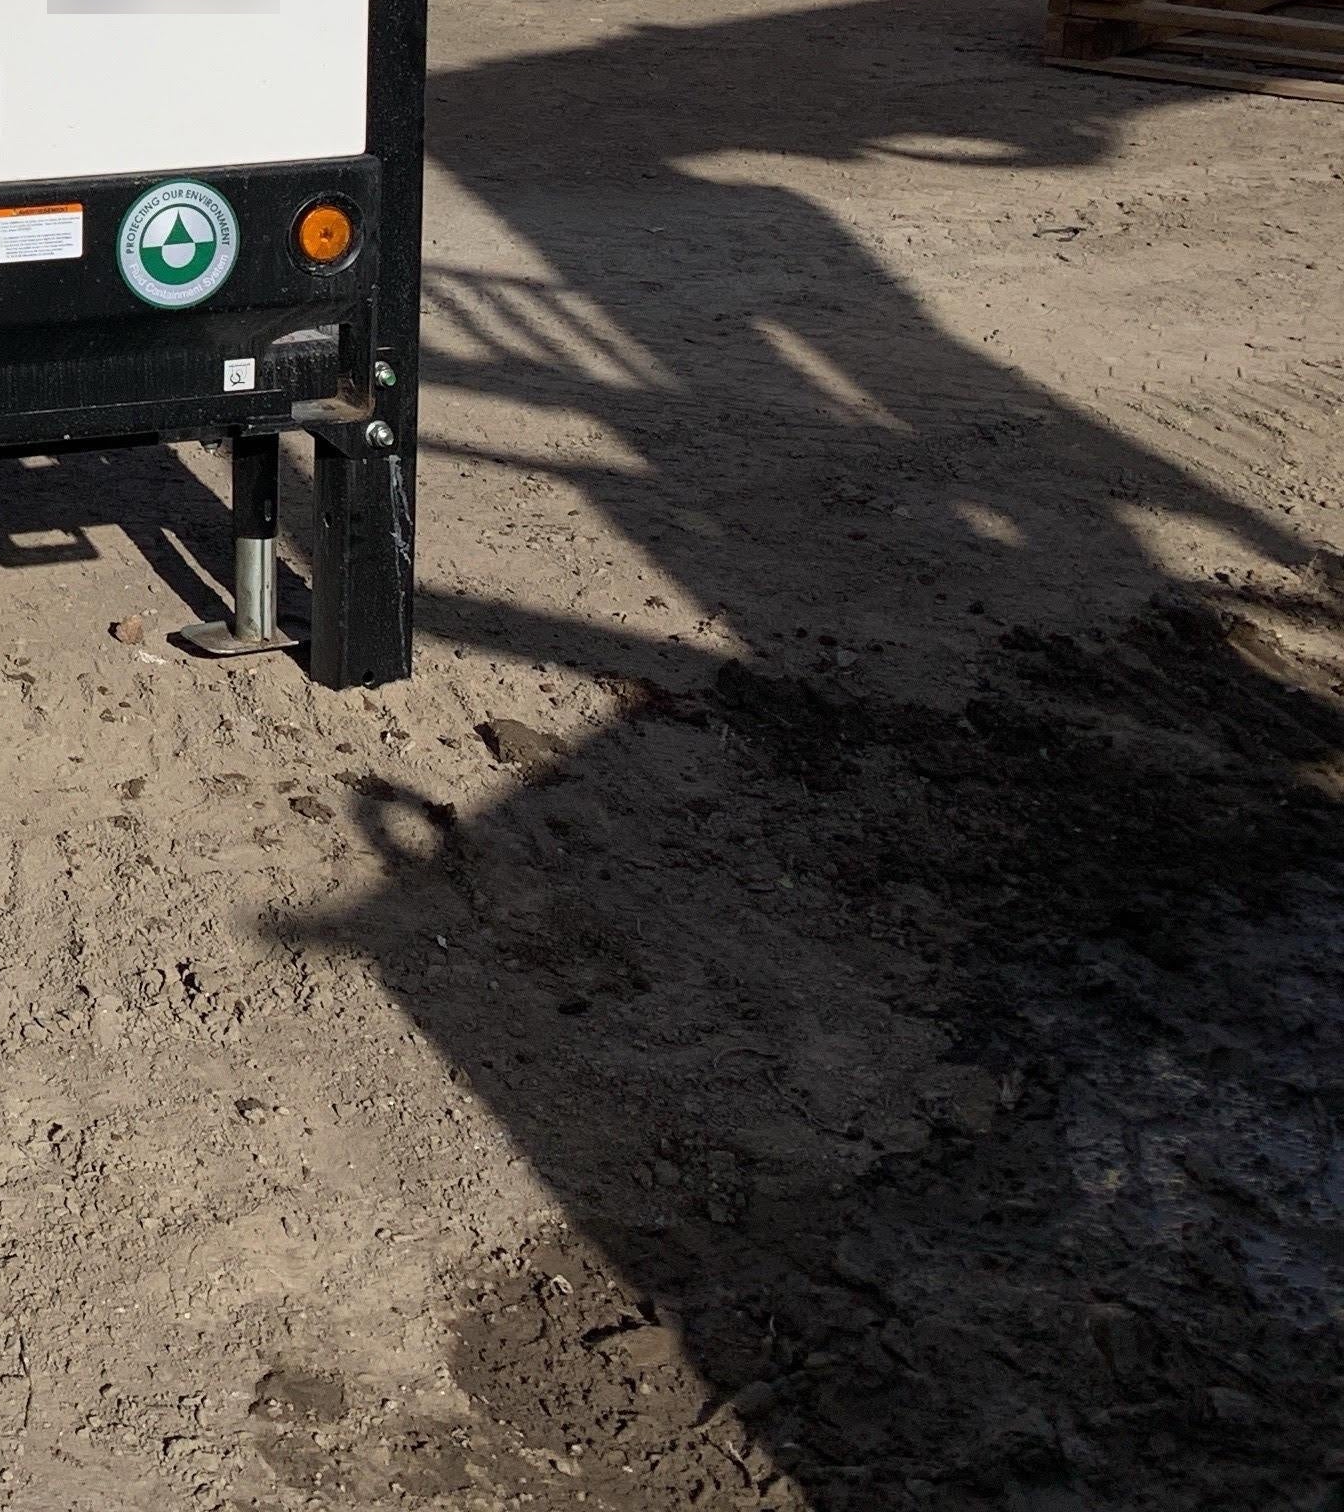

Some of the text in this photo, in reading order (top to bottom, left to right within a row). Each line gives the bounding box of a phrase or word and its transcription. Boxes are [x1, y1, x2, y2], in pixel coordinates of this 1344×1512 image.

[126, 196, 160, 255] PROTECTING
[162, 189, 184, 201] OUR
[185, 189, 230, 246] ENVIRONMENT
[146, 281, 204, 300] Containment
[202, 254, 230, 288] System
